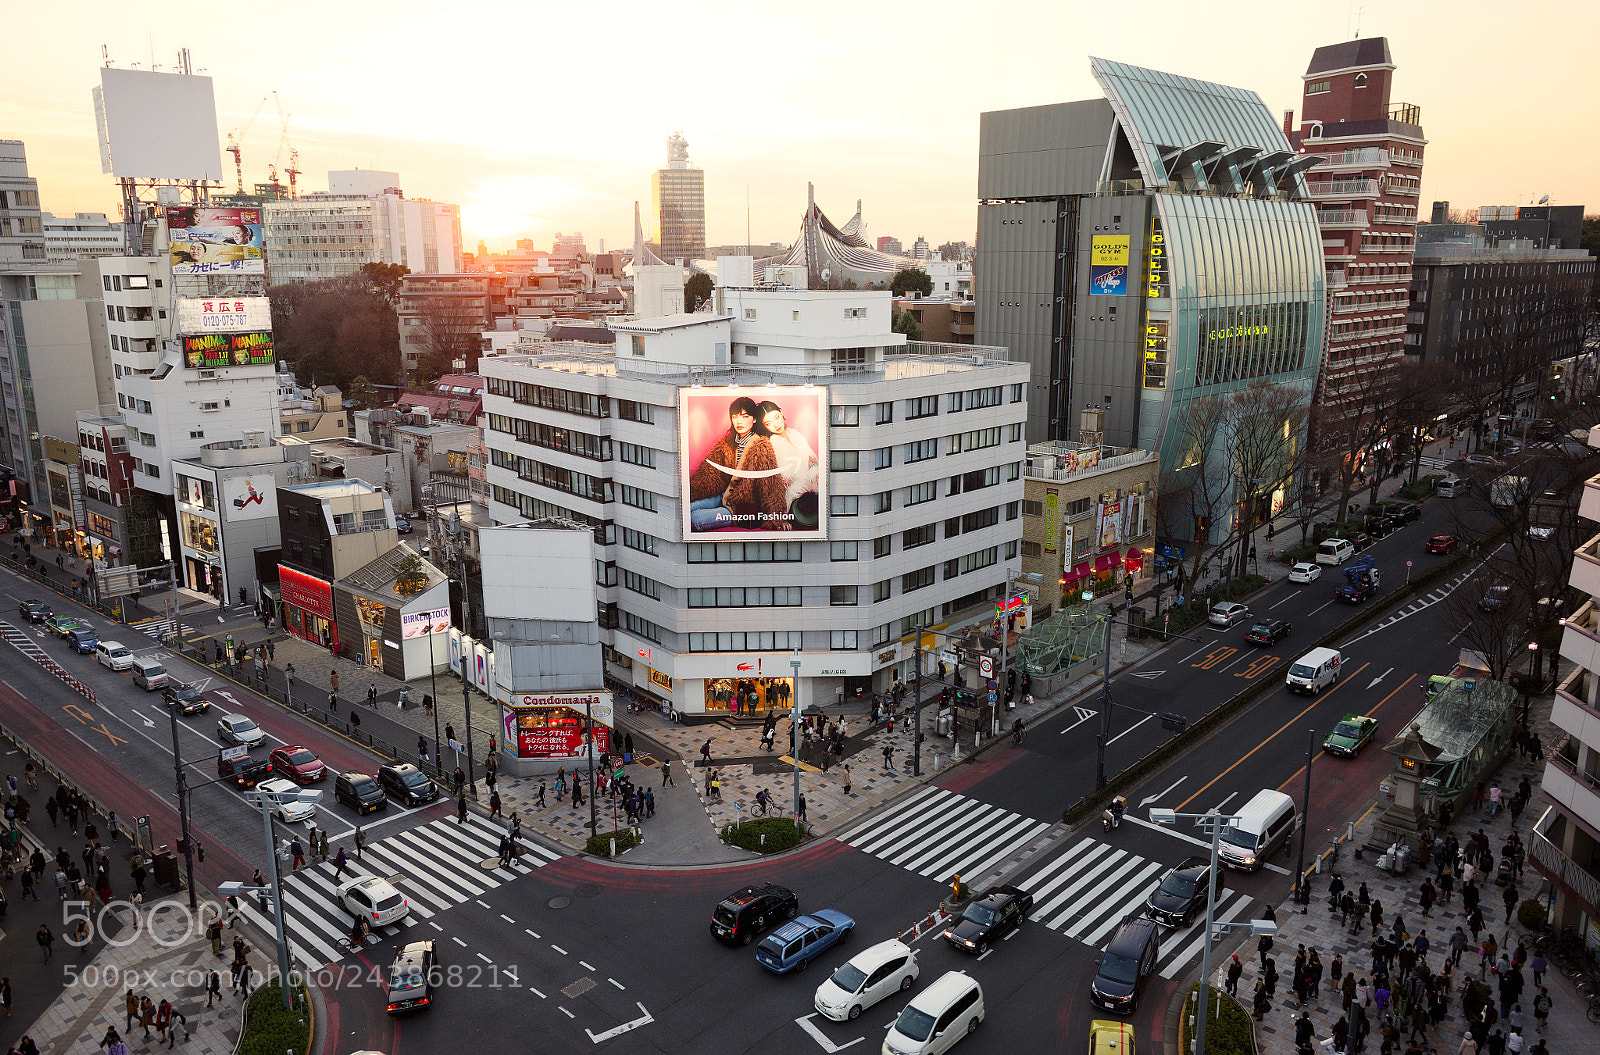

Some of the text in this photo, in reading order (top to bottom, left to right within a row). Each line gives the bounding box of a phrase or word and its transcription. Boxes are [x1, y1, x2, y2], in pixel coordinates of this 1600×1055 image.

[202, 301, 245, 313] 貸広告
[185, 334, 227, 351] WANIMA
[231, 332, 271, 349] WANIMA
[1145, 326, 1159, 360] GYM
[715, 511, 795, 522] Amazon Fashion
[1190, 646, 1238, 670] 50
[1233, 654, 1281, 679] 50
[1324, 655, 1340, 672] FedEx
[523, 695, 600, 705] Condomania
